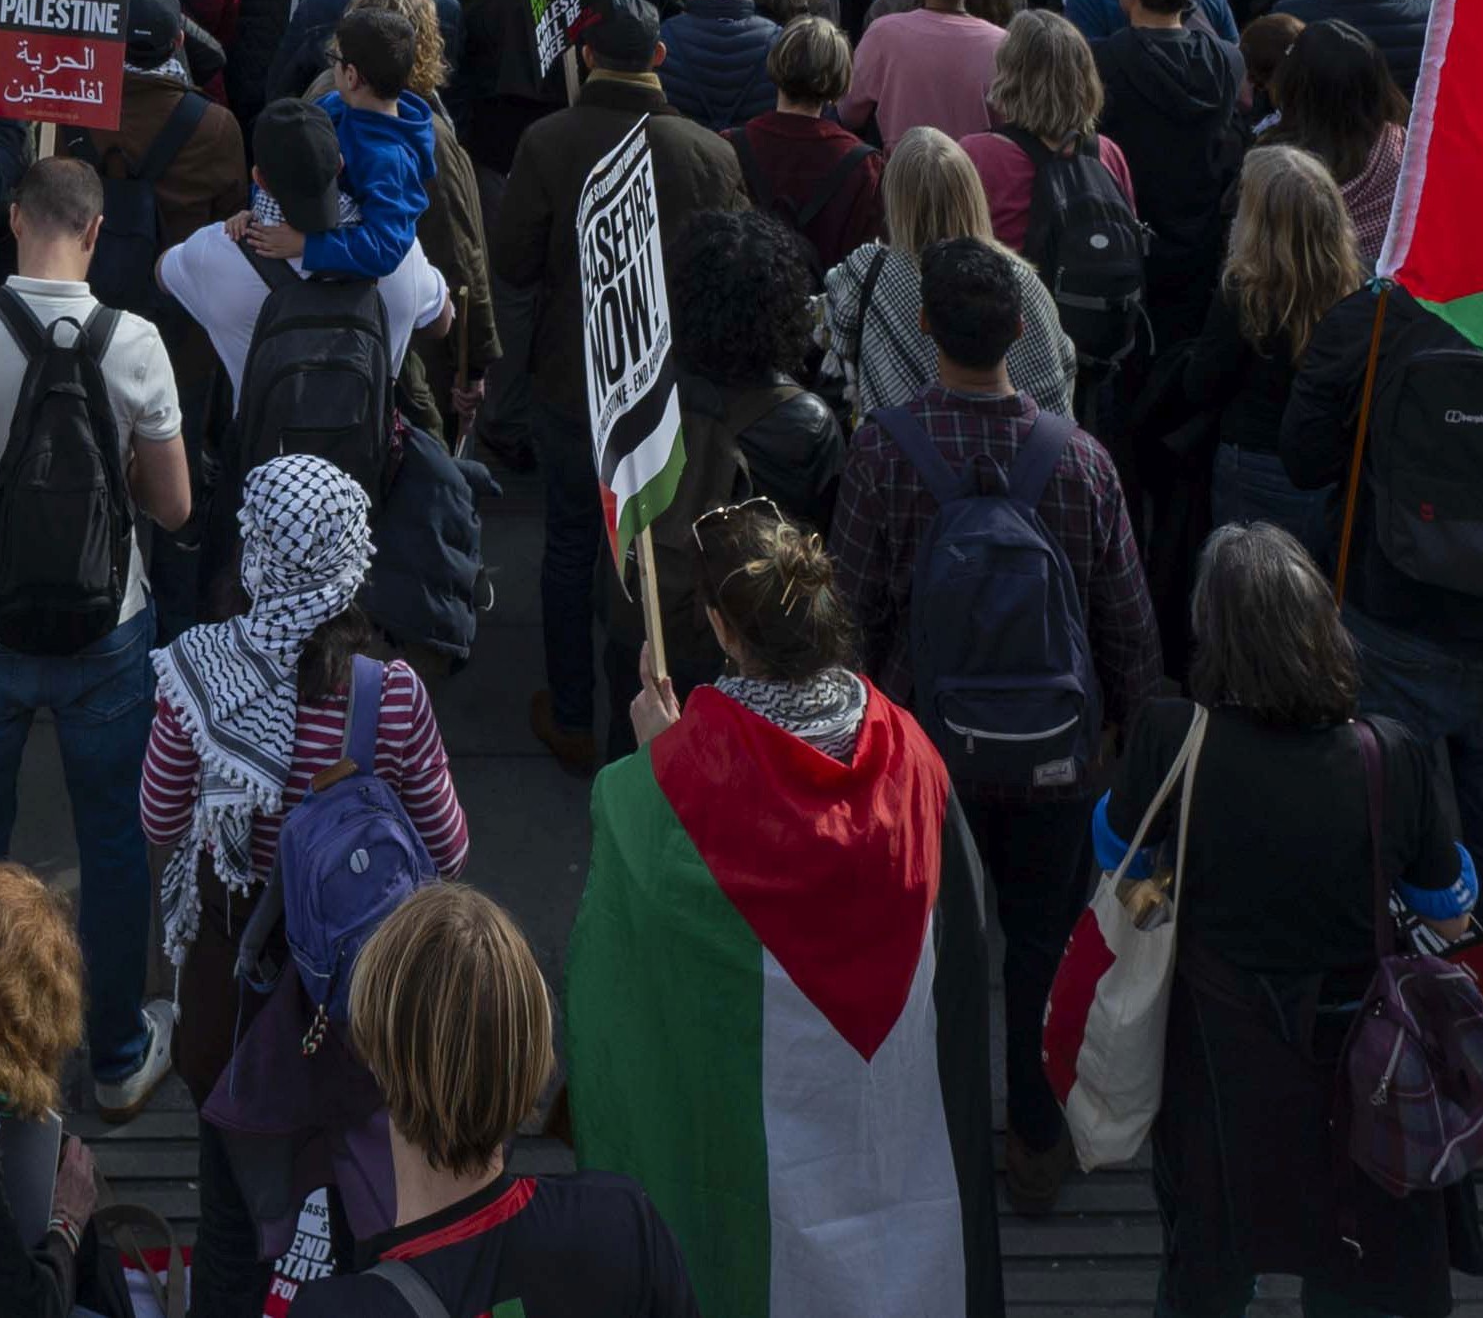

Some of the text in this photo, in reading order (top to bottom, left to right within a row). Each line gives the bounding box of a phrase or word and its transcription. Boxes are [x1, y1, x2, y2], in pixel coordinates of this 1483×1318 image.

[16, 38, 95, 74] الحرية
[537, 19, 564, 61] WILL
[540, 33, 566, 79] FREE
[4, 75, 104, 105] لفلسطين
[588, 251, 659, 412] NOW!
[634, 364, 648, 391] END
[280, 1253, 334, 1283] TATE
